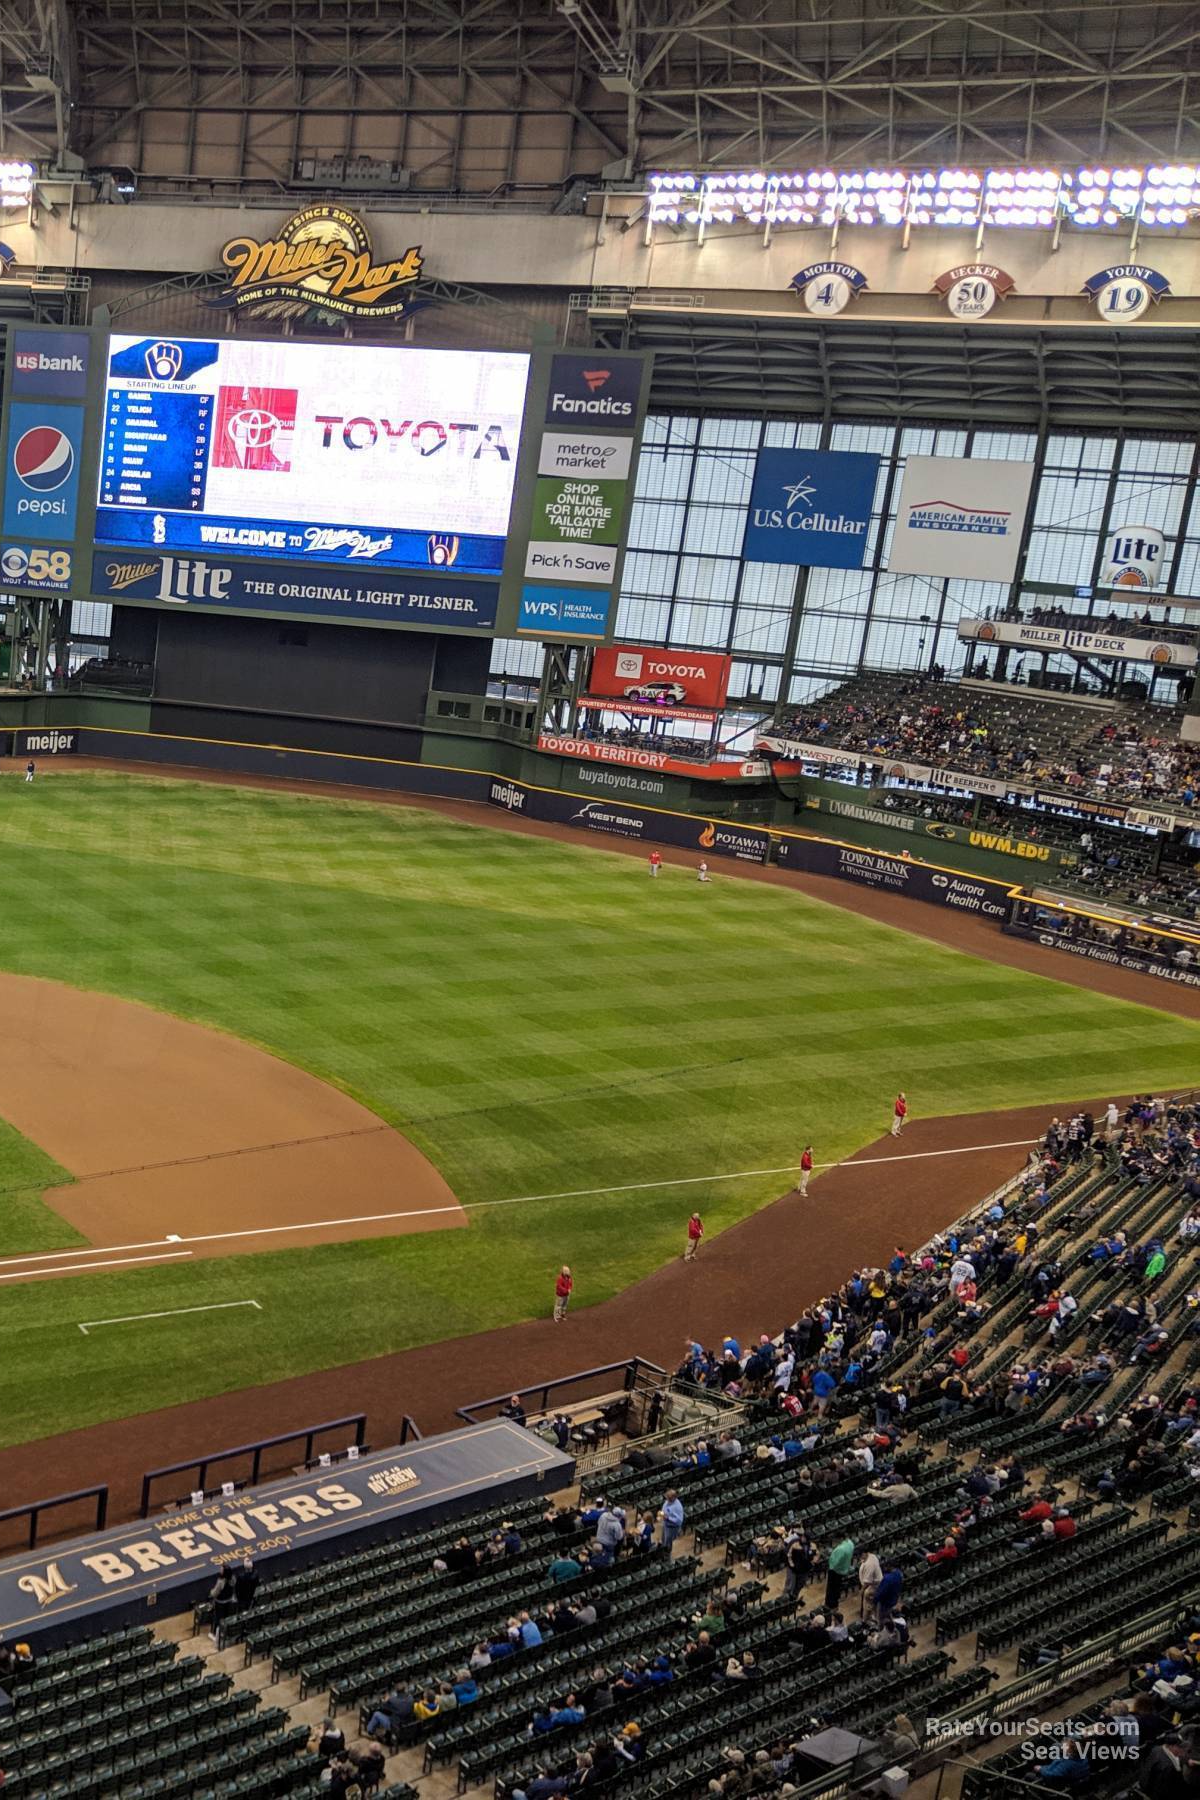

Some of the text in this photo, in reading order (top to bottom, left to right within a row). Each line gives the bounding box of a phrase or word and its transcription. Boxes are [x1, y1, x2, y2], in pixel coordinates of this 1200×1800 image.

[293, 208, 357, 229] SINCE 2001
[222, 237, 346, 294] Miller
[318, 245, 423, 304] Park
[803, 264, 857, 280] MOLITOR
[949, 266, 1000, 280] UECKER
[1106, 267, 1153, 279] YOUNT
[237, 288, 404, 316] HOME OF THE MILWAUKEE BREWERS
[816, 283, 833, 306] 4
[957, 282, 987, 303] 50
[1104, 287, 1144, 313] 19
[126, 381, 196, 390] STARTING LINEUP
[552, 393, 632, 415] Fanatics
[315, 415, 511, 462] TOYOTA
[557, 443, 601, 456] metro
[556, 456, 606, 469] market
[564, 483, 599, 494] SHOP
[17, 499, 67, 516] pepsi
[556, 494, 604, 506] ONLINE
[545, 504, 612, 518] FOR MORE
[910, 511, 1009, 526] AMERICAN FAMILY
[548, 515, 606, 529] TAILGATE
[559, 526, 592, 538] TIME!
[754, 509, 866, 535] U.S. Cellular
[915, 521, 999, 534] INSURANCE
[200, 525, 302, 548] WELCOME TO
[1111, 537, 1159, 565] Lite
[27, 549, 71, 582] 58
[532, 554, 611, 571] Pick Save
[2, 577, 69, 589] WDJT MILWAUKEE
[105, 556, 479, 613] Miller Lite THE ORIGINAL LIGHT PILSNER.
[524, 601, 558, 616] WPS
[564, 604, 592, 612] HEALTH
[564, 611, 605, 621] INSURANCE
[1020, 629, 1125, 651] MILLER Lite DECK
[648, 662, 706, 679] TOYOTA
[641, 690, 664, 699] RAV4
[578, 699, 606, 709] COURTESY
[632, 705, 665, 714] WISCONSIN
[665, 709, 687, 717] TOYOTA
[688, 711, 713, 720] DEALERS
[27, 731, 73, 753] meijer
[541, 737, 668, 768] TOYOTA TERRITORY
[578, 767, 664, 794] buyatoyota.com
[953, 778, 990, 791] BEERPEN
[491, 783, 525, 809] meijer
[589, 811, 643, 828] WEST BEND
[1149, 814, 1171, 827] WTMJ
[969, 831, 1049, 861] UWM.EDU
[840, 850, 910, 879] TOWN BANK
[847, 866, 903, 887] WINTRUST BANK
[949, 879, 985, 897] Aurora
[945, 892, 1006, 917] Health Care
[1055, 940, 1087, 955] Aurora
[1087, 949, 1119, 964] Health
[1121, 956, 1142, 970] Care
[368, 1480, 389, 1494] MY
[385, 1467, 417, 1486] CREW
[155, 1496, 256, 1531] HOME OF THE
[81, 1484, 362, 1584] BREWERS
[210, 1535, 294, 1566] SINCE 2001
